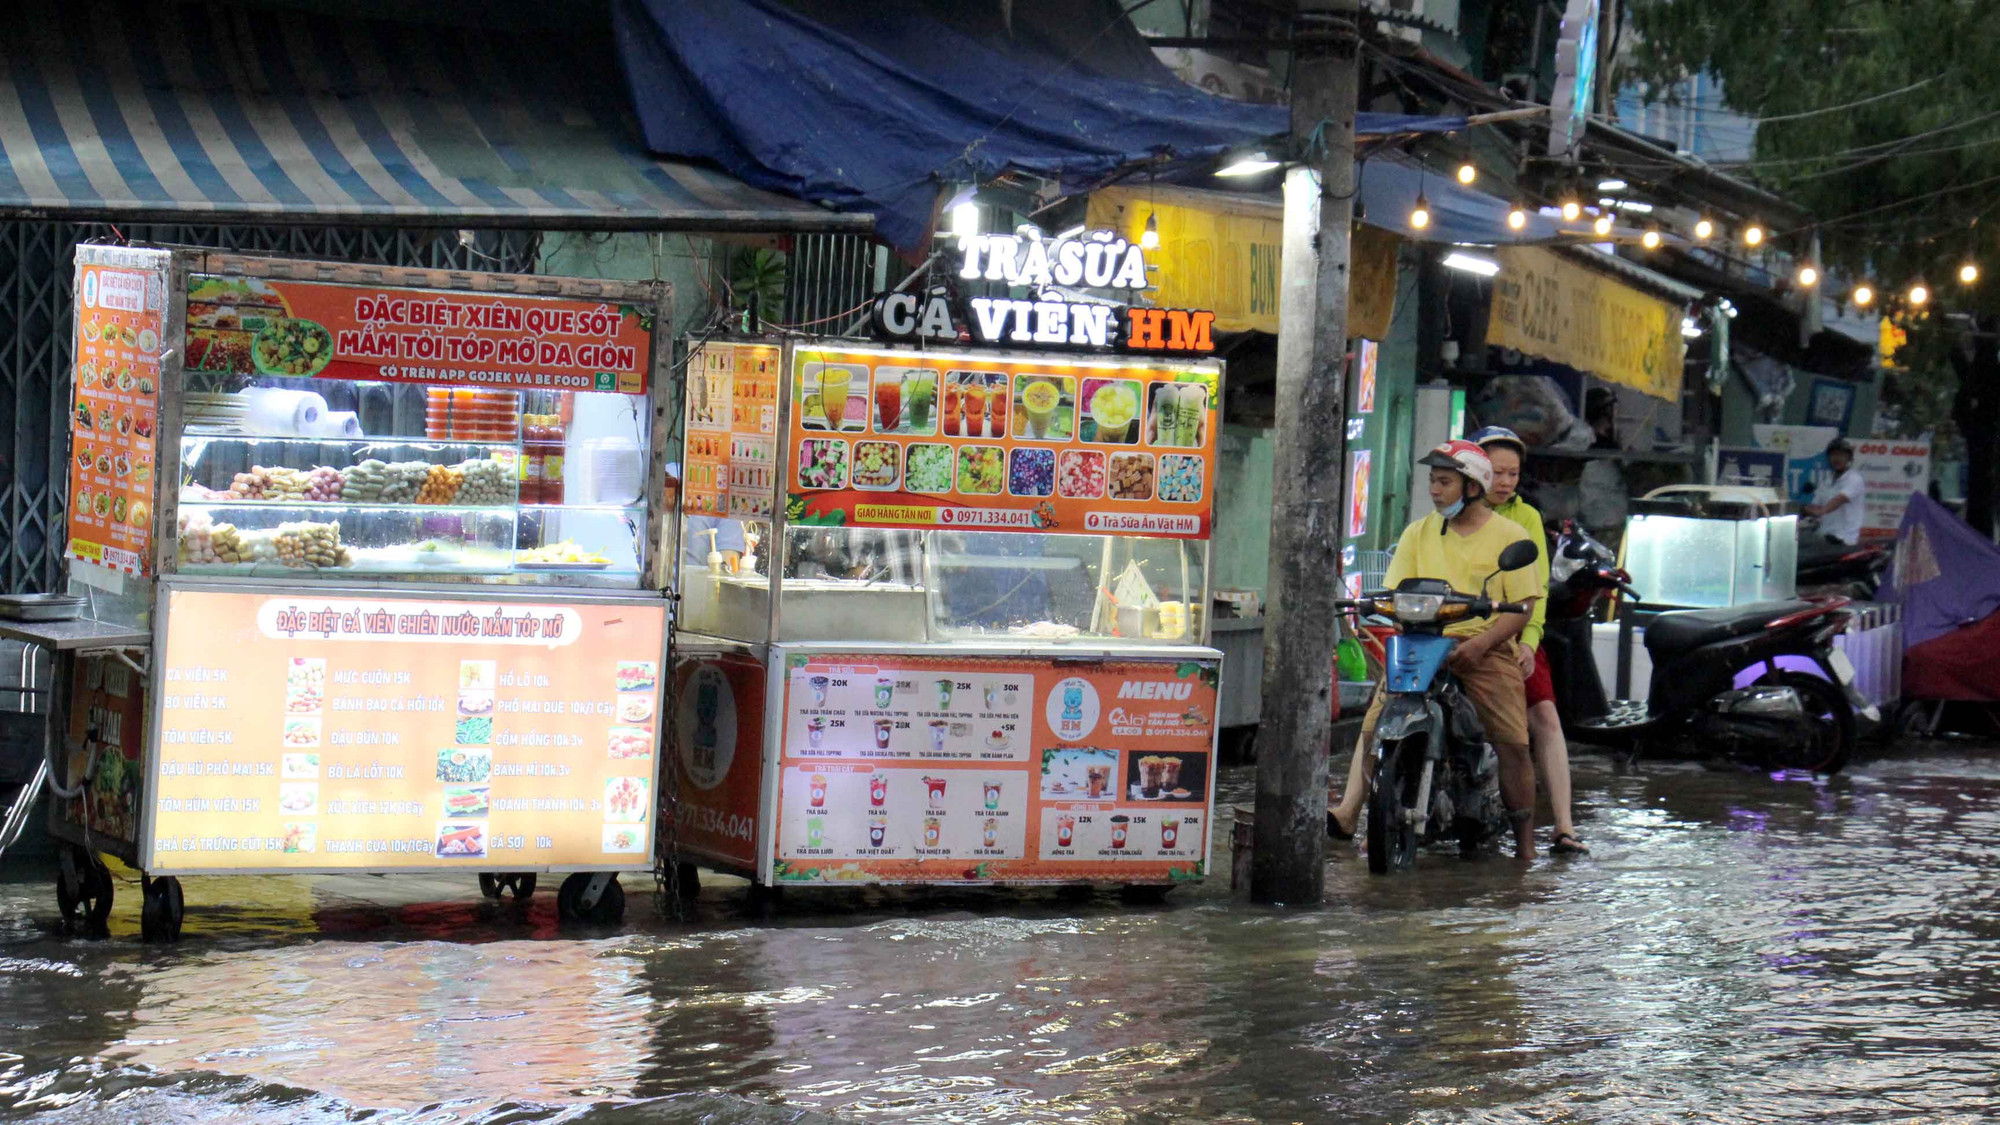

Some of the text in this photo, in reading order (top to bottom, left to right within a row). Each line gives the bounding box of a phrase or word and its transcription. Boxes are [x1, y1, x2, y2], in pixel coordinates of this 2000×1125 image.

[958, 225, 1051, 287] TRÀ
[1053, 228, 1148, 289] SỮA
[355, 294, 623, 338] ĐẶC BIỆT XIÊN QUE SỐT
[882, 285, 1215, 351] CÁ VIÊN HM
[337, 323, 635, 371] MẮM TỎI TÓP MỠ DA GIÒN
[379, 364, 398, 377] CÓ
[401, 365, 435, 379] TRÊN
[438, 369, 466, 381] APP
[468, 370, 511, 383] GOJEK
[514, 371, 532, 384] VÀ
[535, 374, 551, 385] BE
[553, 375, 589, 387] FOOD
[857, 508, 875, 519] GIAO
[877, 506, 900, 520] HÀNG
[917, 509, 932, 521] NƠI
[957, 511, 1029, 525] 0971.334.041
[1103, 515, 1118, 528] Trà
[1120, 514, 1139, 529] Sữa
[1177, 520, 1193, 531] HM
[277, 606, 565, 639] ĐẶC BIỆT CÁ VIÊN CHIÊN NƯỚC MẮM TÓP MỠ
[185, 664, 210, 682] VIÊN
[212, 668, 229, 681] 5K
[334, 668, 412, 689] MỰC CUỘN 15K
[533, 674, 550, 687] 10k
[831, 679, 848, 687] 20K
[957, 682, 971, 690] 25K
[1117, 681, 1193, 700] MENU
[184, 692, 209, 710] VIÊN
[212, 696, 227, 709] 5K
[366, 698, 387, 711] BAO
[428, 699, 446, 711] 10K
[521, 701, 541, 714] MAI
[544, 701, 566, 714] QUE
[830, 719, 845, 728] 25K
[189, 727, 216, 745] VIÊN
[218, 731, 233, 744] 5K
[382, 732, 400, 744] 10K
[553, 734, 569, 746] 10k
[161, 759, 184, 779] ĐẬU
[207, 758, 230, 776] PHÔ
[232, 763, 252, 776] MAI
[255, 763, 274, 776] 15K
[386, 766, 404, 779] 10K
[541, 765, 557, 776] 10k
[213, 795, 239, 812] VIÊN
[242, 799, 261, 812] 15K
[672, 800, 754, 842] 971.334.041
[200, 835, 238, 851] TRỨNG
[265, 839, 284, 851] 15K
[325, 840, 364, 853] THANH
[366, 841, 388, 853] CUA
[507, 836, 524, 852] SỢI
[536, 837, 553, 848] 10k
